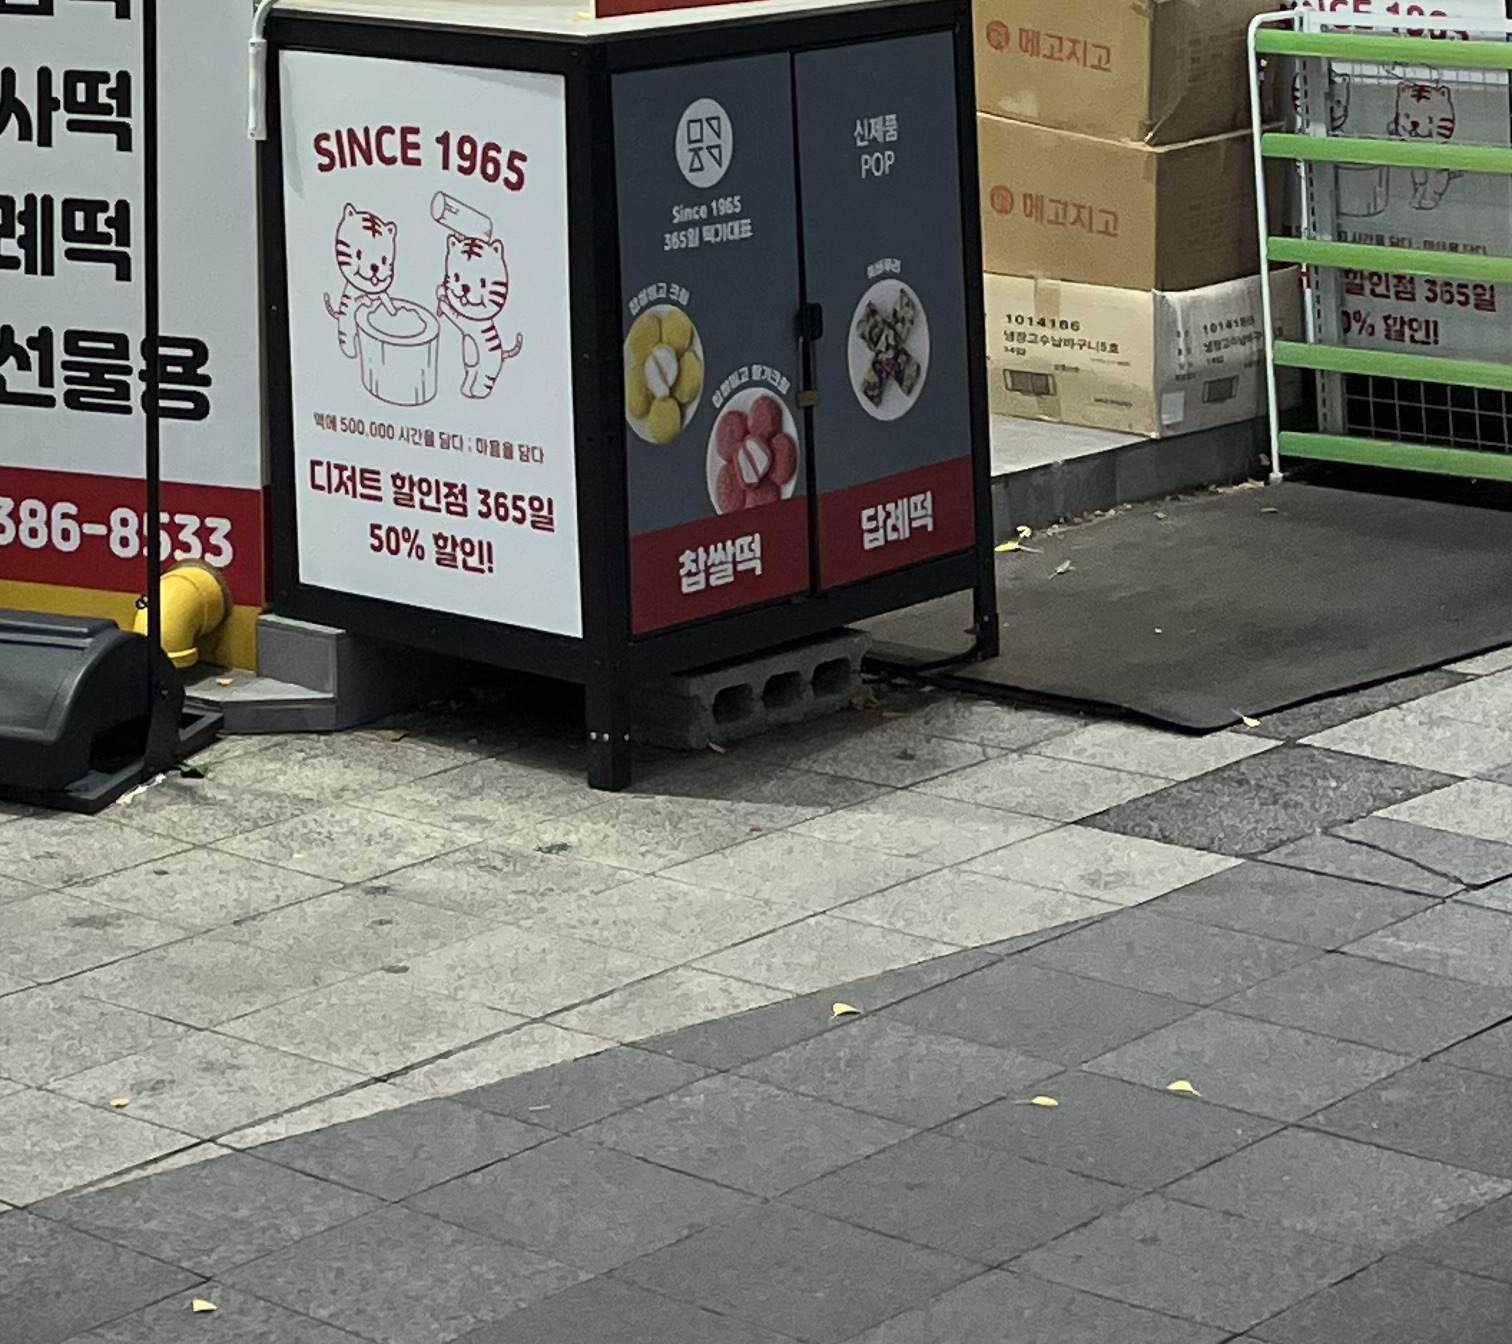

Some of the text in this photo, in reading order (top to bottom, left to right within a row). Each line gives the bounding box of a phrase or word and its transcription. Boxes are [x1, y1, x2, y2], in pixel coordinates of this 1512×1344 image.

[1018, 27, 1112, 72] 메고지고
[853, 114, 899, 147] 신제품
[314, 125, 528, 192] SINCE 1965
[861, 151, 896, 179] POP
[672, 195, 742, 224] Since 1965
[1022, 192, 1120, 238] 메고지고
[663, 226, 700, 251] 365일
[1424, 278, 1496, 313] 365일
[1383, 314, 1439, 345] 할인!
[340, 419, 395, 441] 500,000
[398, 425, 435, 448] 시간을
[439, 431, 464, 452] 담다
[476, 437, 514, 460] 마음을
[518, 444, 545, 464] 담다
[310, 459, 555, 533] 디저트 할인점 365일
[861, 491, 934, 551] 답례떡
[370, 523, 495, 574] 50% 할인!
[678, 534, 763, 594] 찹쌀떡
